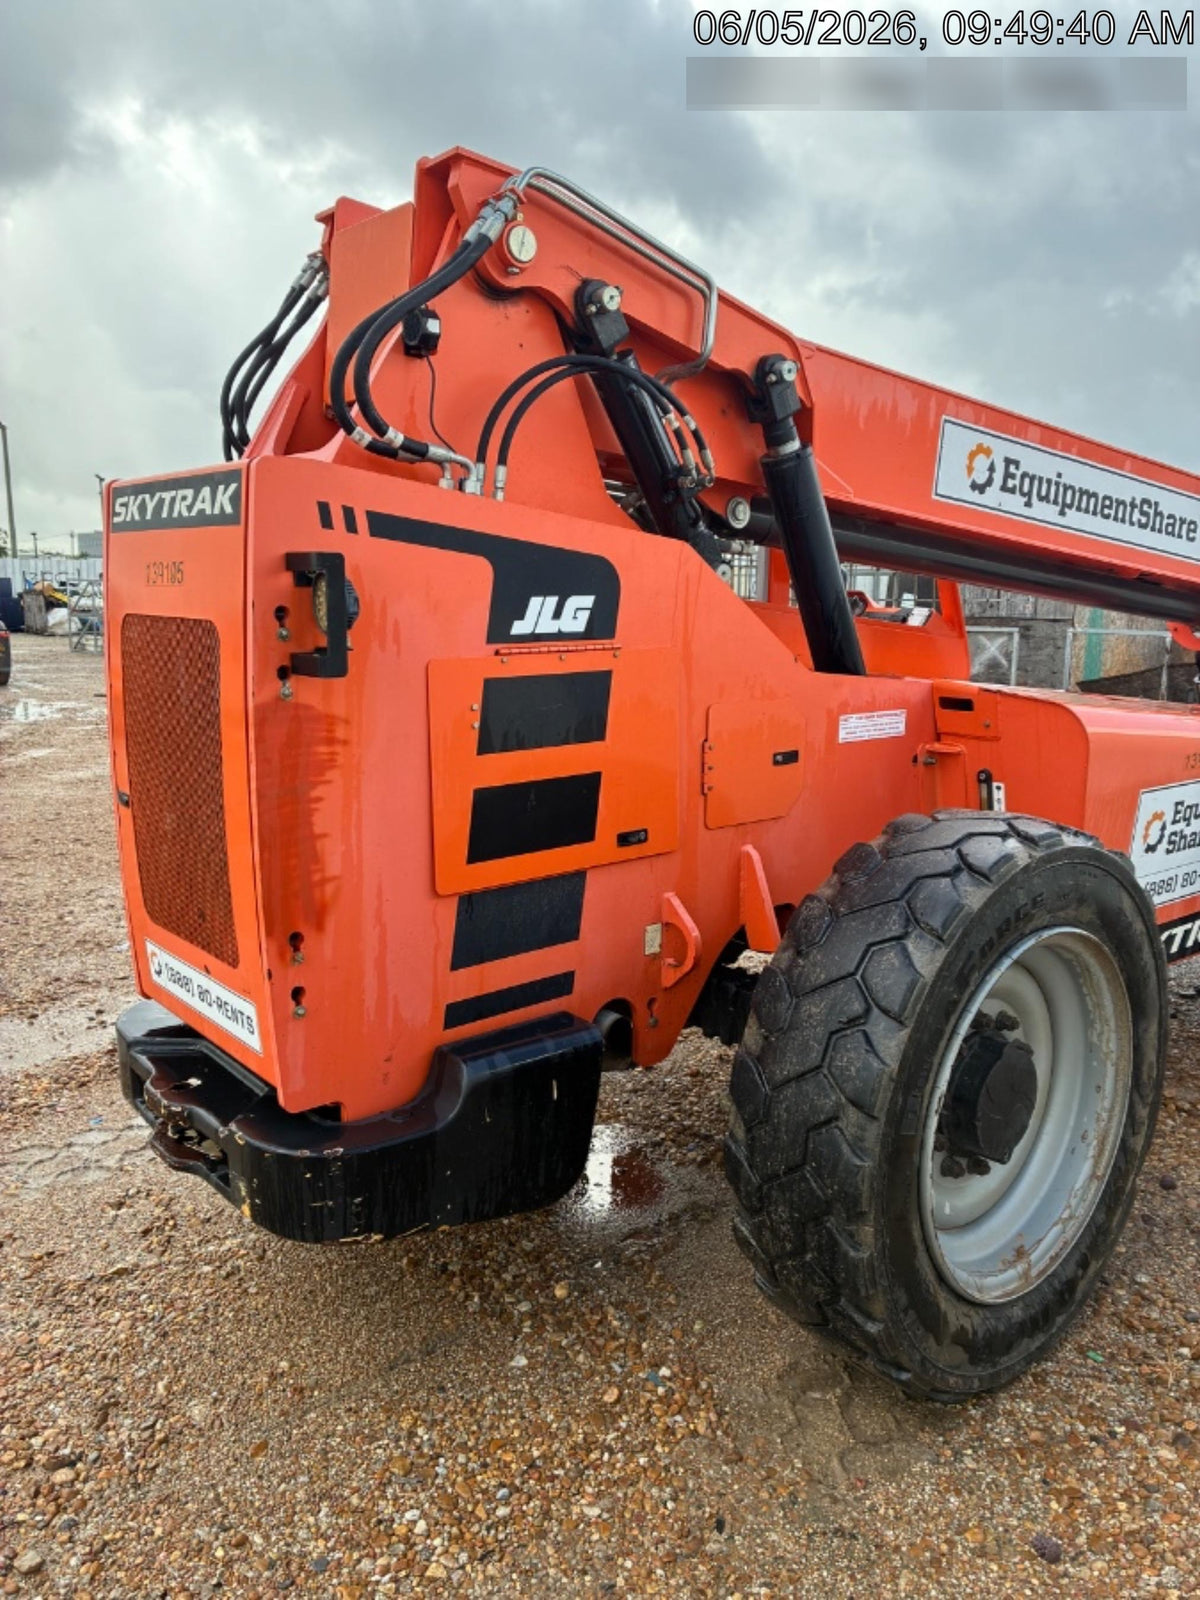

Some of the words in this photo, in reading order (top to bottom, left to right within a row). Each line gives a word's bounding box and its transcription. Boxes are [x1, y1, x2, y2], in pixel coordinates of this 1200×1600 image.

[112, 483, 239, 523] SKYTRAK
[999, 456, 1199, 542] EquipmentShare
[509, 594, 597, 636] JLG
[197, 984, 256, 1036] 80-RENTS
